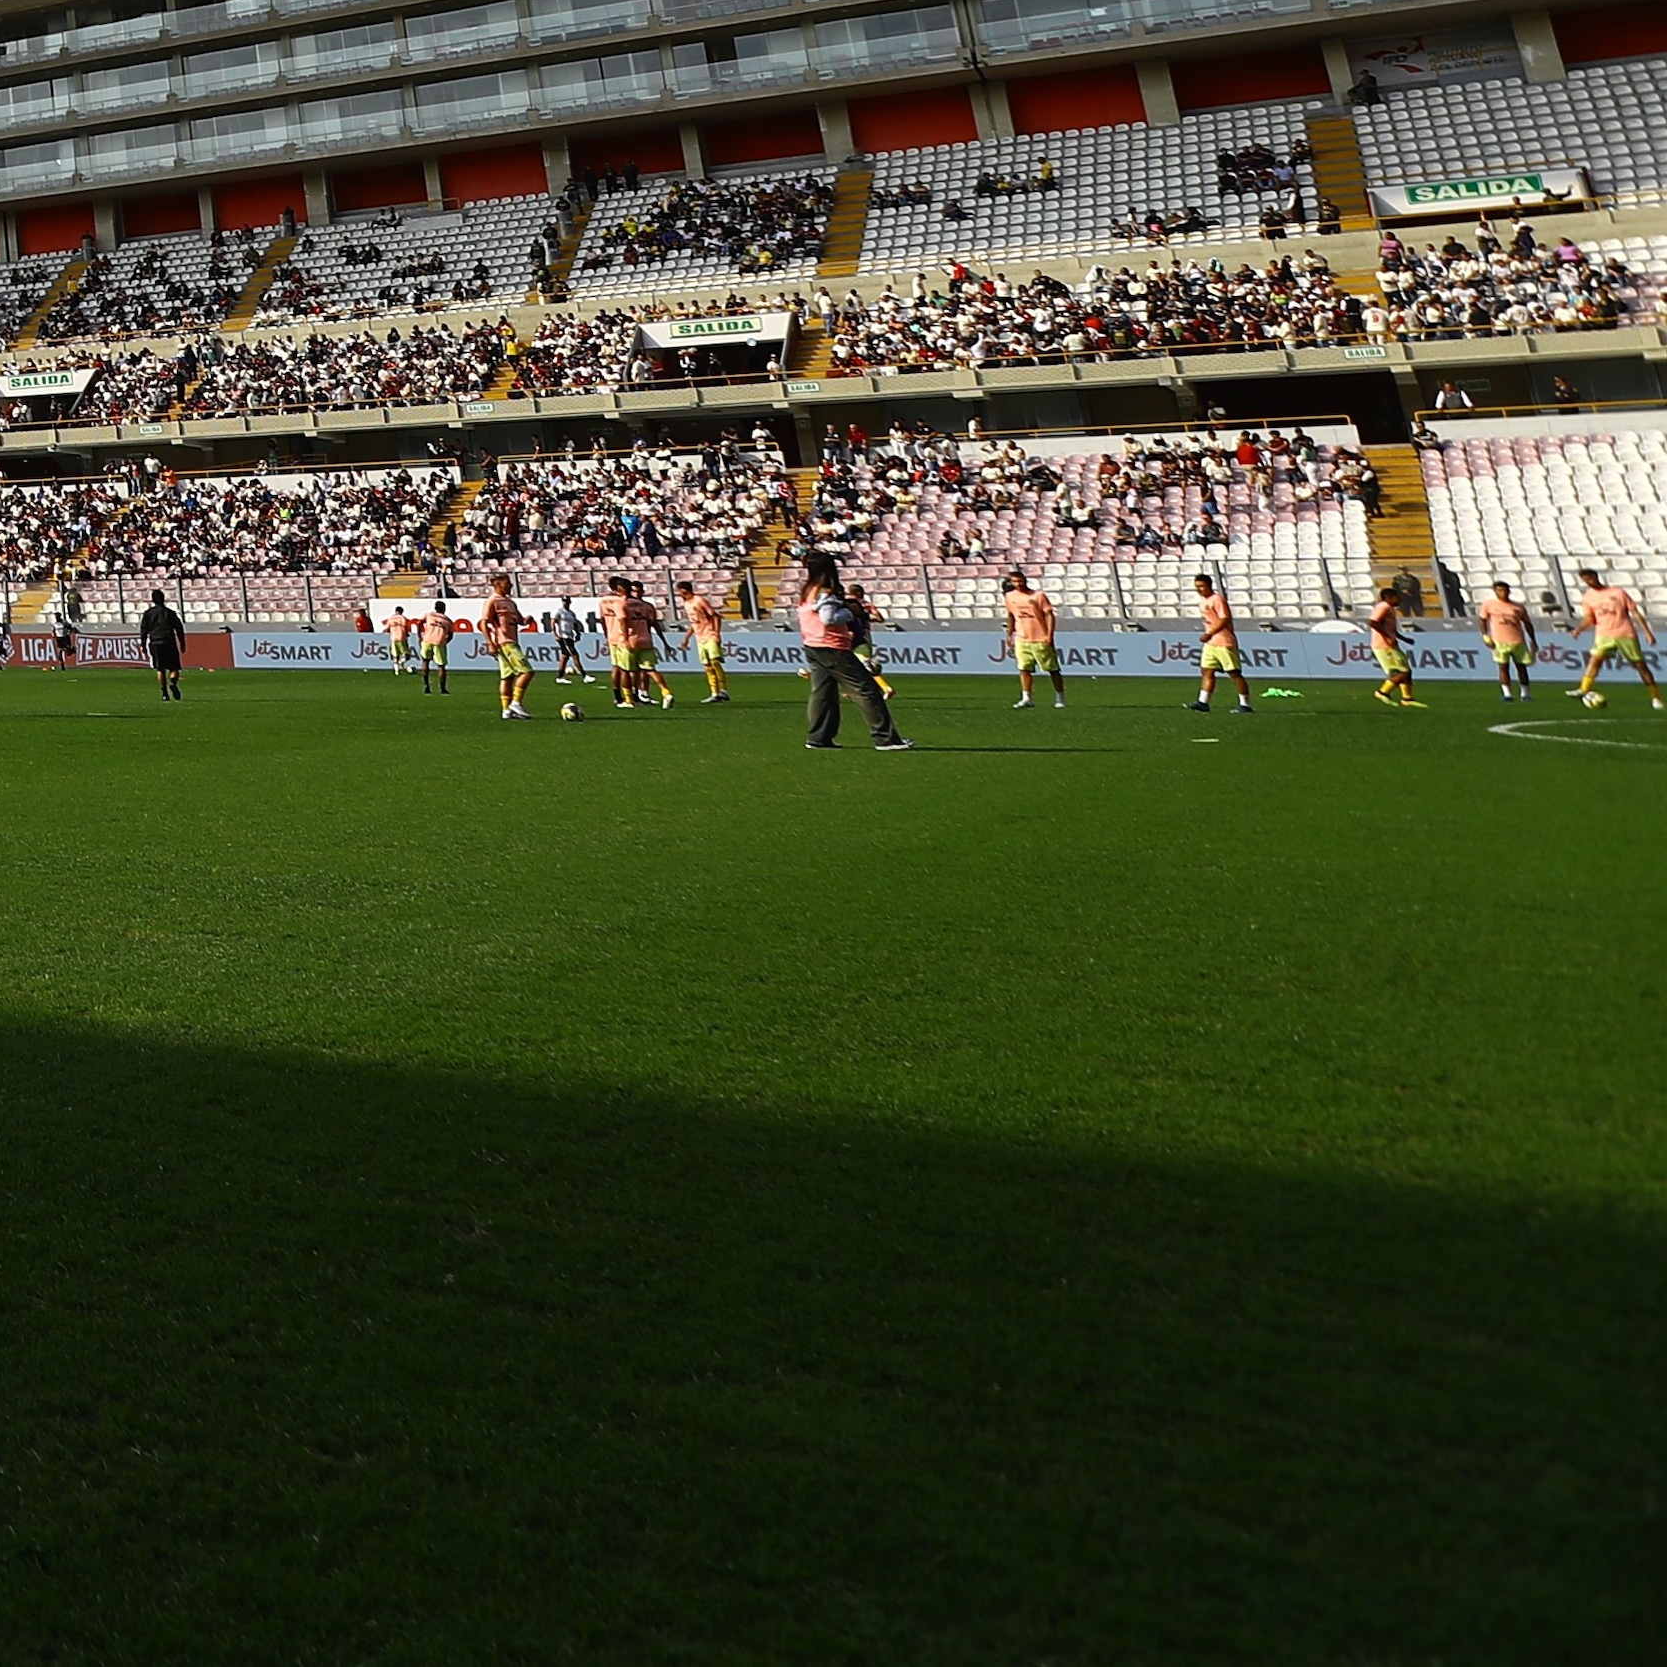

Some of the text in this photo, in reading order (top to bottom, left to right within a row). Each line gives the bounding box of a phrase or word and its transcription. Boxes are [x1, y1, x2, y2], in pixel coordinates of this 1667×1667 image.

[1415, 177, 1535, 201] SALIDA
[679, 320, 754, 334] SALIDA
[11, 374, 70, 387] SALIDA
[20, 638, 57, 662] LIGA
[78, 638, 93, 661] TE
[245, 639, 332, 660] JetSMART
